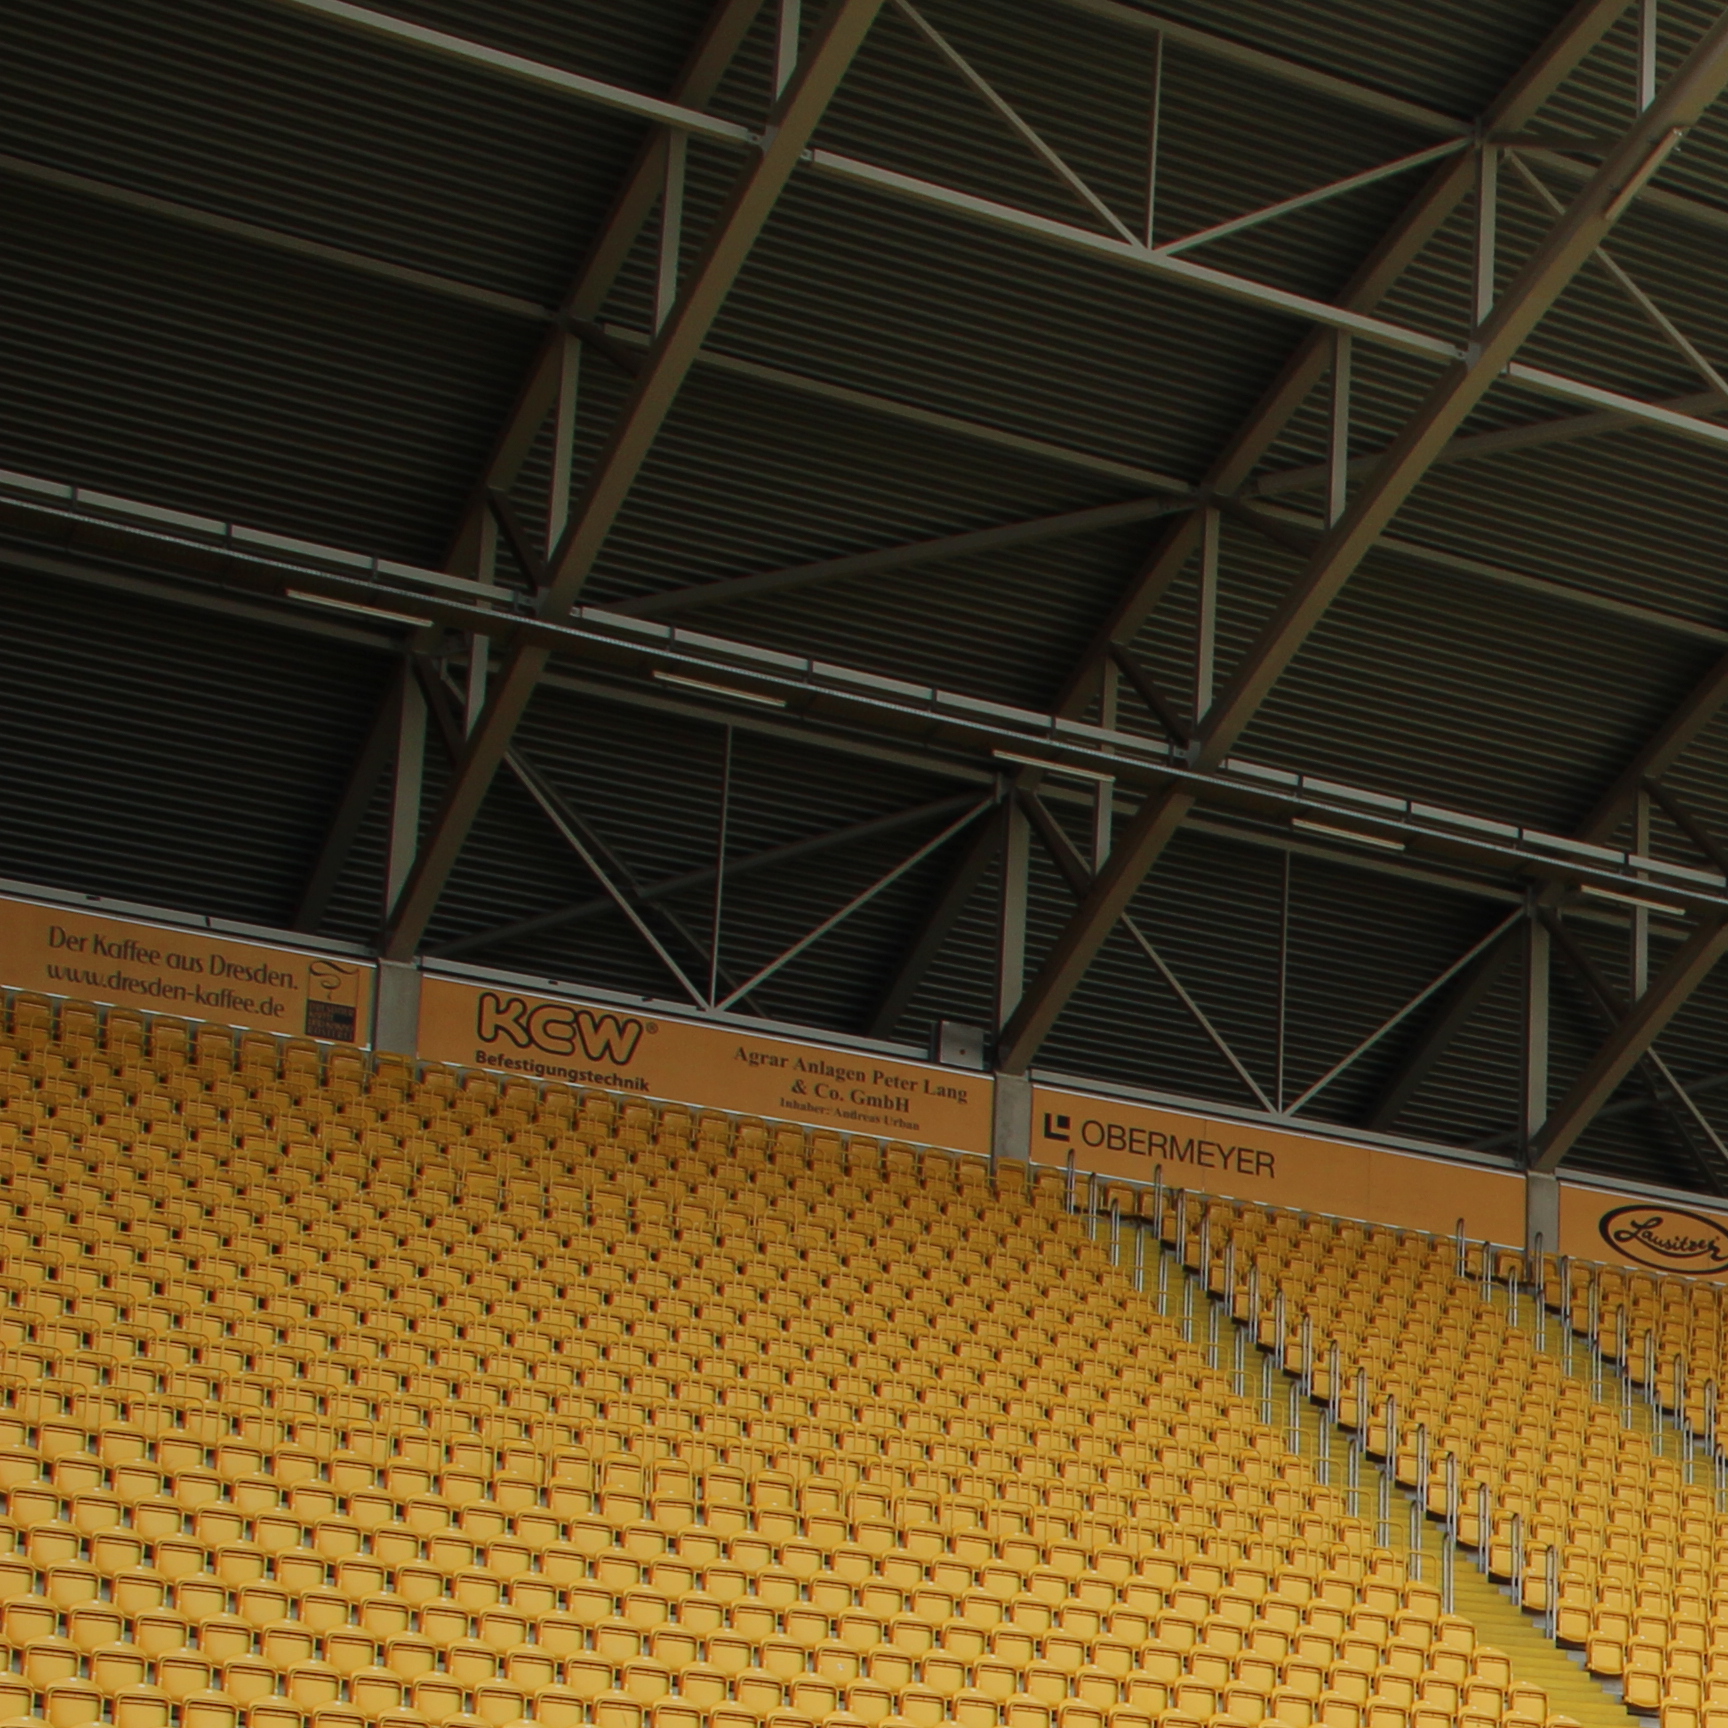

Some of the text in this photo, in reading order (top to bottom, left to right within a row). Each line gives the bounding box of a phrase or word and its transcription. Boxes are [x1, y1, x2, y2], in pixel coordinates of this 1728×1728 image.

[49, 926, 299, 991] Der Kaffee aus Dresden.
[47, 962, 286, 1018] www.dresden-kaffee.de
[475, 1050, 650, 1092] Befestigungstechnik
[734, 1047, 968, 1104] Agrar Anlagen Peter Lang
[791, 1079, 910, 1113] & Co. GmbH
[834, 1107, 881, 1125] Andreas
[1081, 1120, 1276, 1179] OBERMEYER
